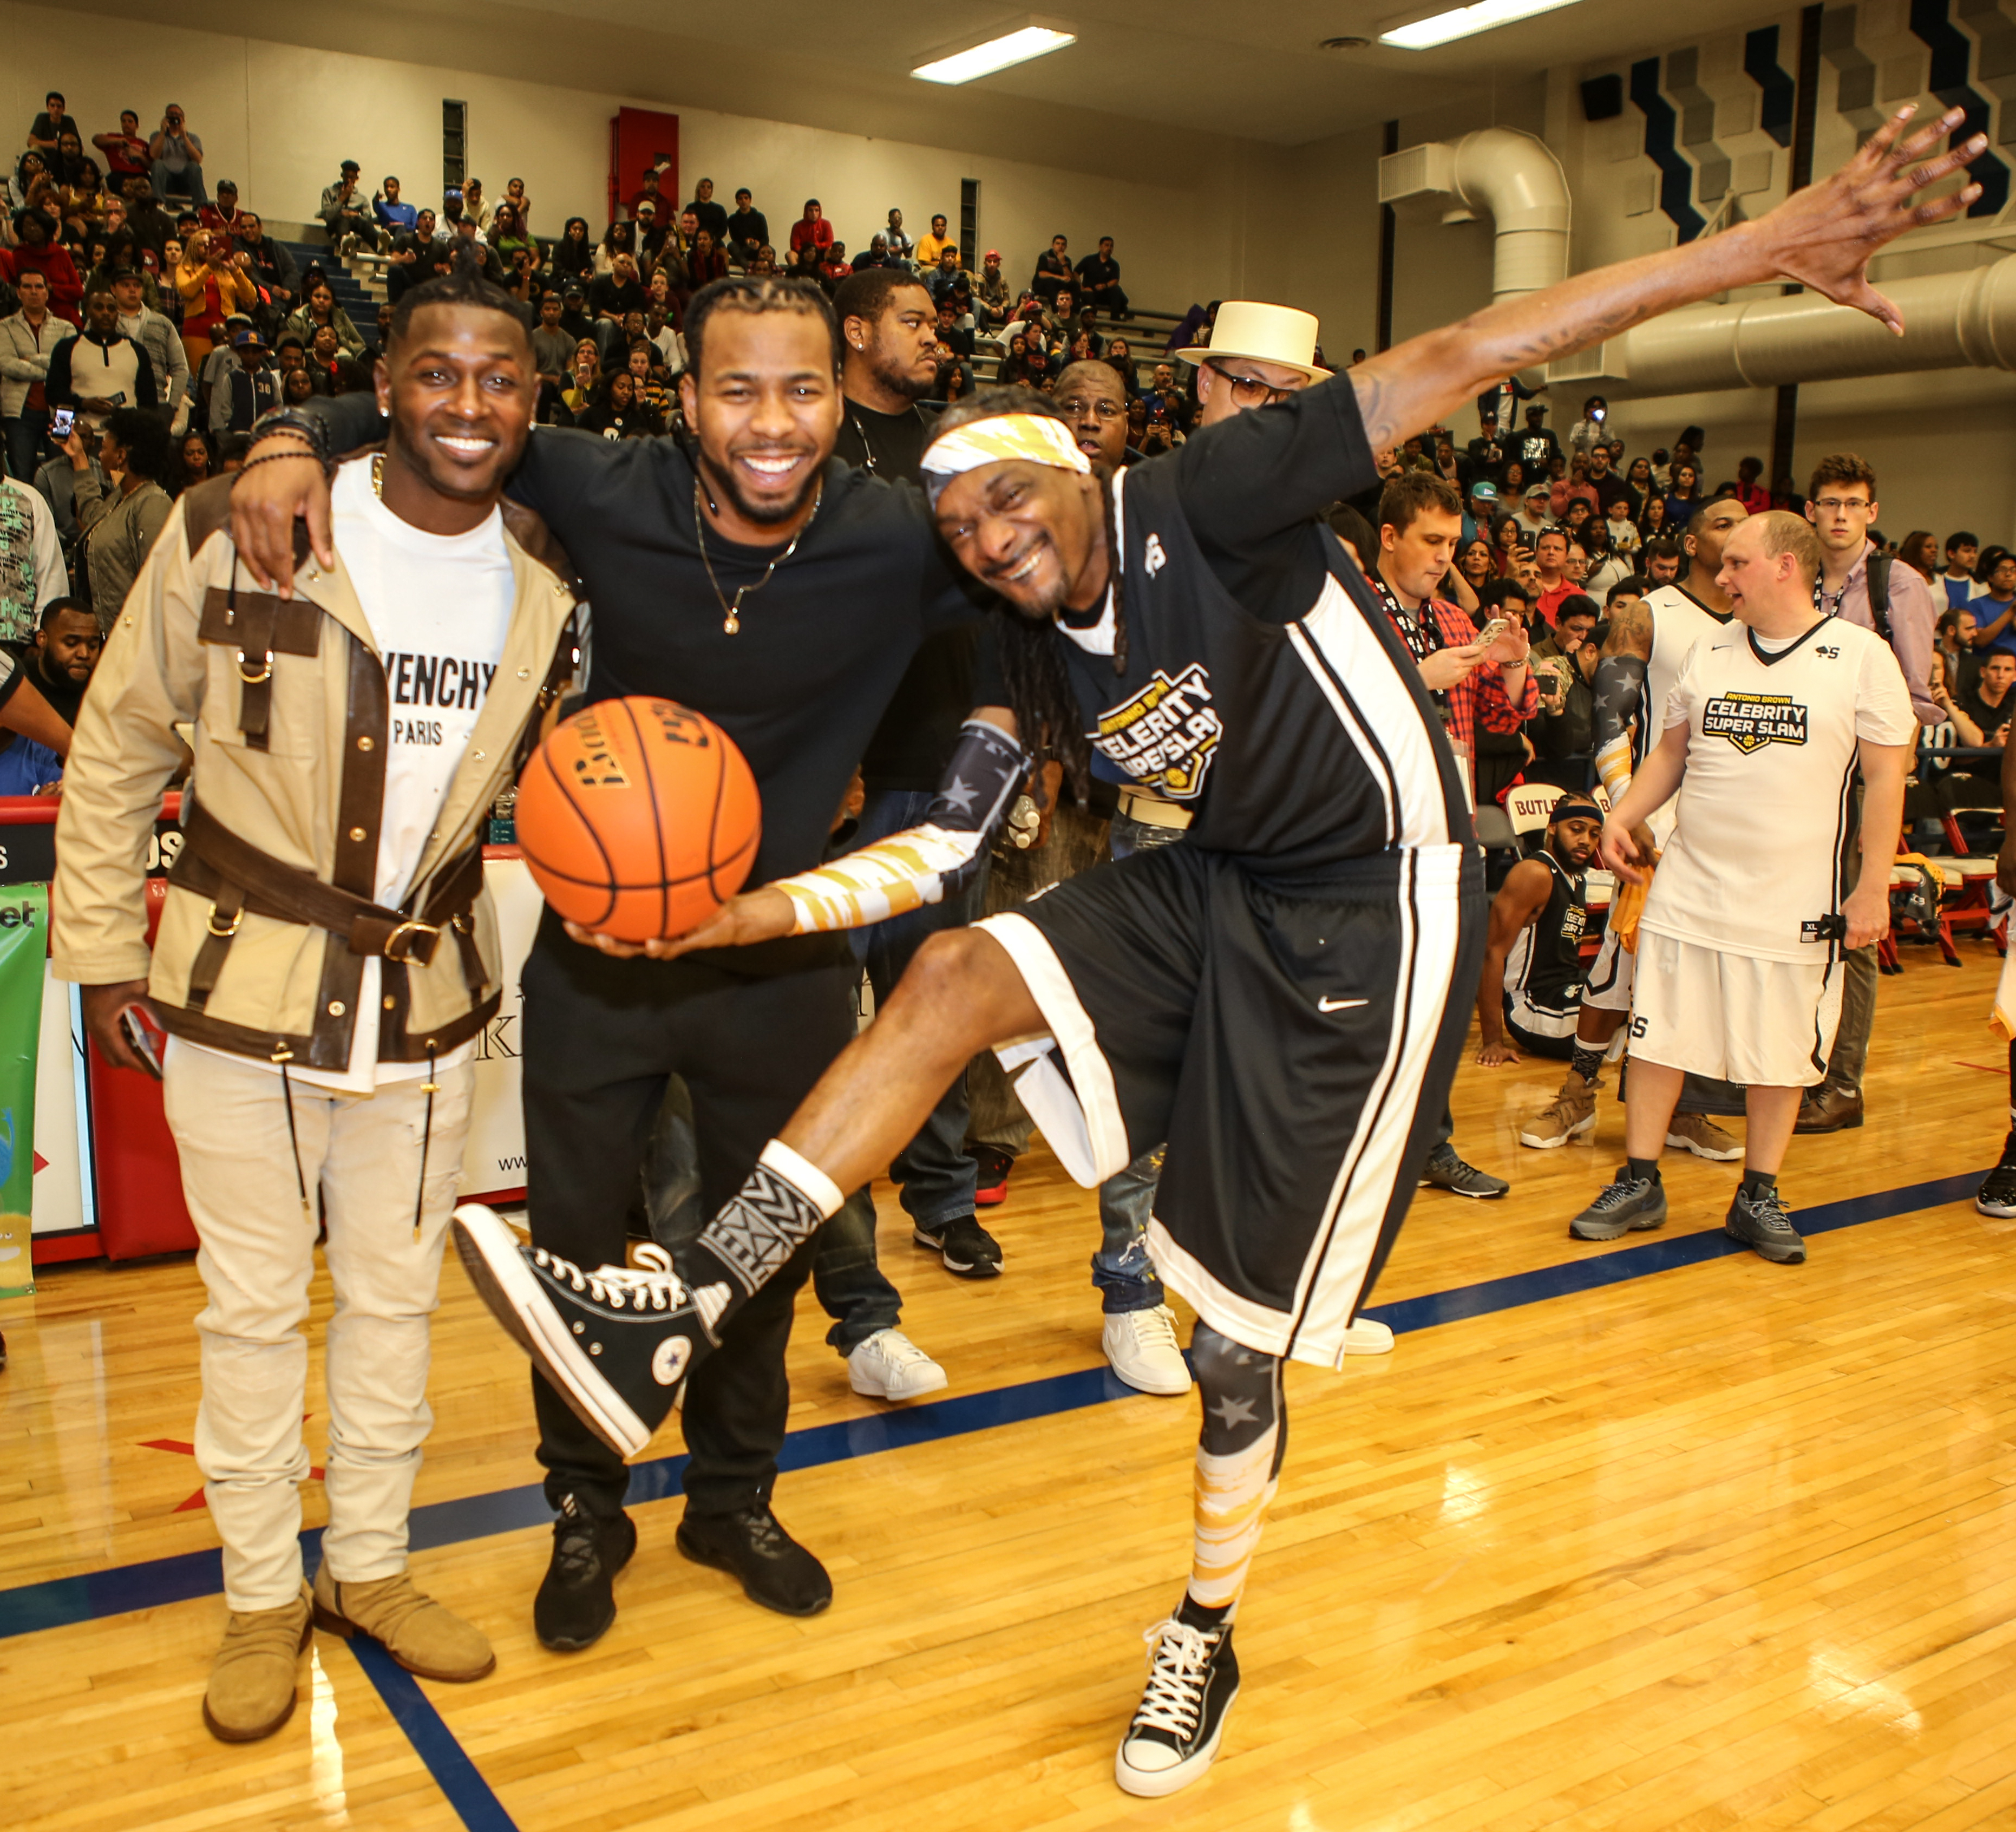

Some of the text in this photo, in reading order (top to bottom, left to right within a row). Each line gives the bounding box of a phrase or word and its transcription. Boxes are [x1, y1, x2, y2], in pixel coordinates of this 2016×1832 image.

[1726, 692, 1791, 704] ANTONIO BROWN
[1707, 699, 1806, 723] CELEBRITY
[393, 719, 443, 745] PARIS
[1704, 716, 1804, 739] SUPER SLAM
